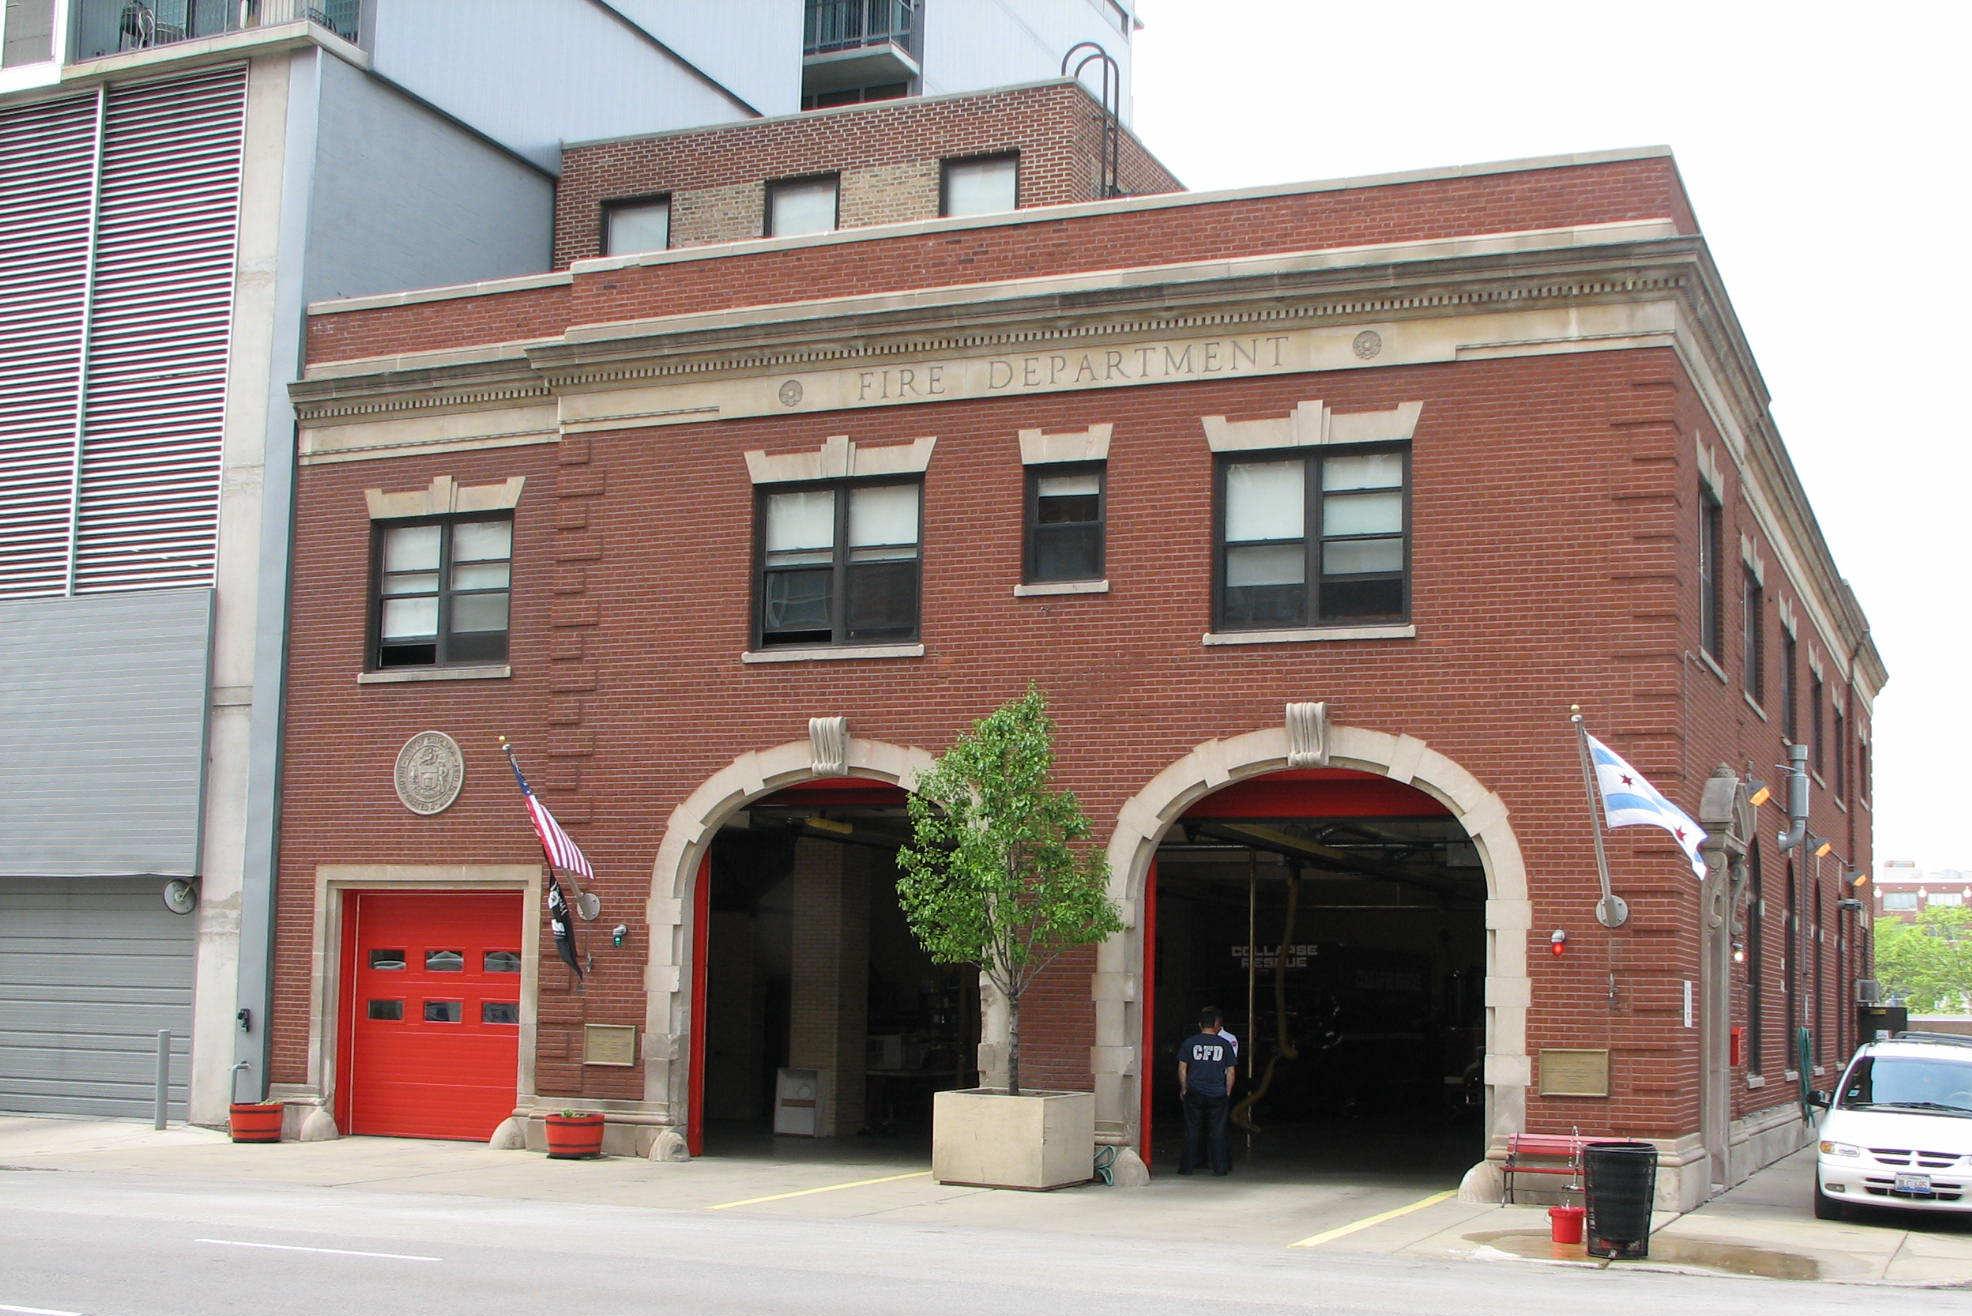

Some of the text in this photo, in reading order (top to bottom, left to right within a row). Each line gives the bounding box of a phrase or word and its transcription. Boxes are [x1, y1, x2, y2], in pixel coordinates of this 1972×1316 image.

[858, 336, 1289, 401] FIRE DEPARTMENT
[1231, 944, 1318, 957] COLLAPSE
[1193, 1044, 1223, 1061] CFD
